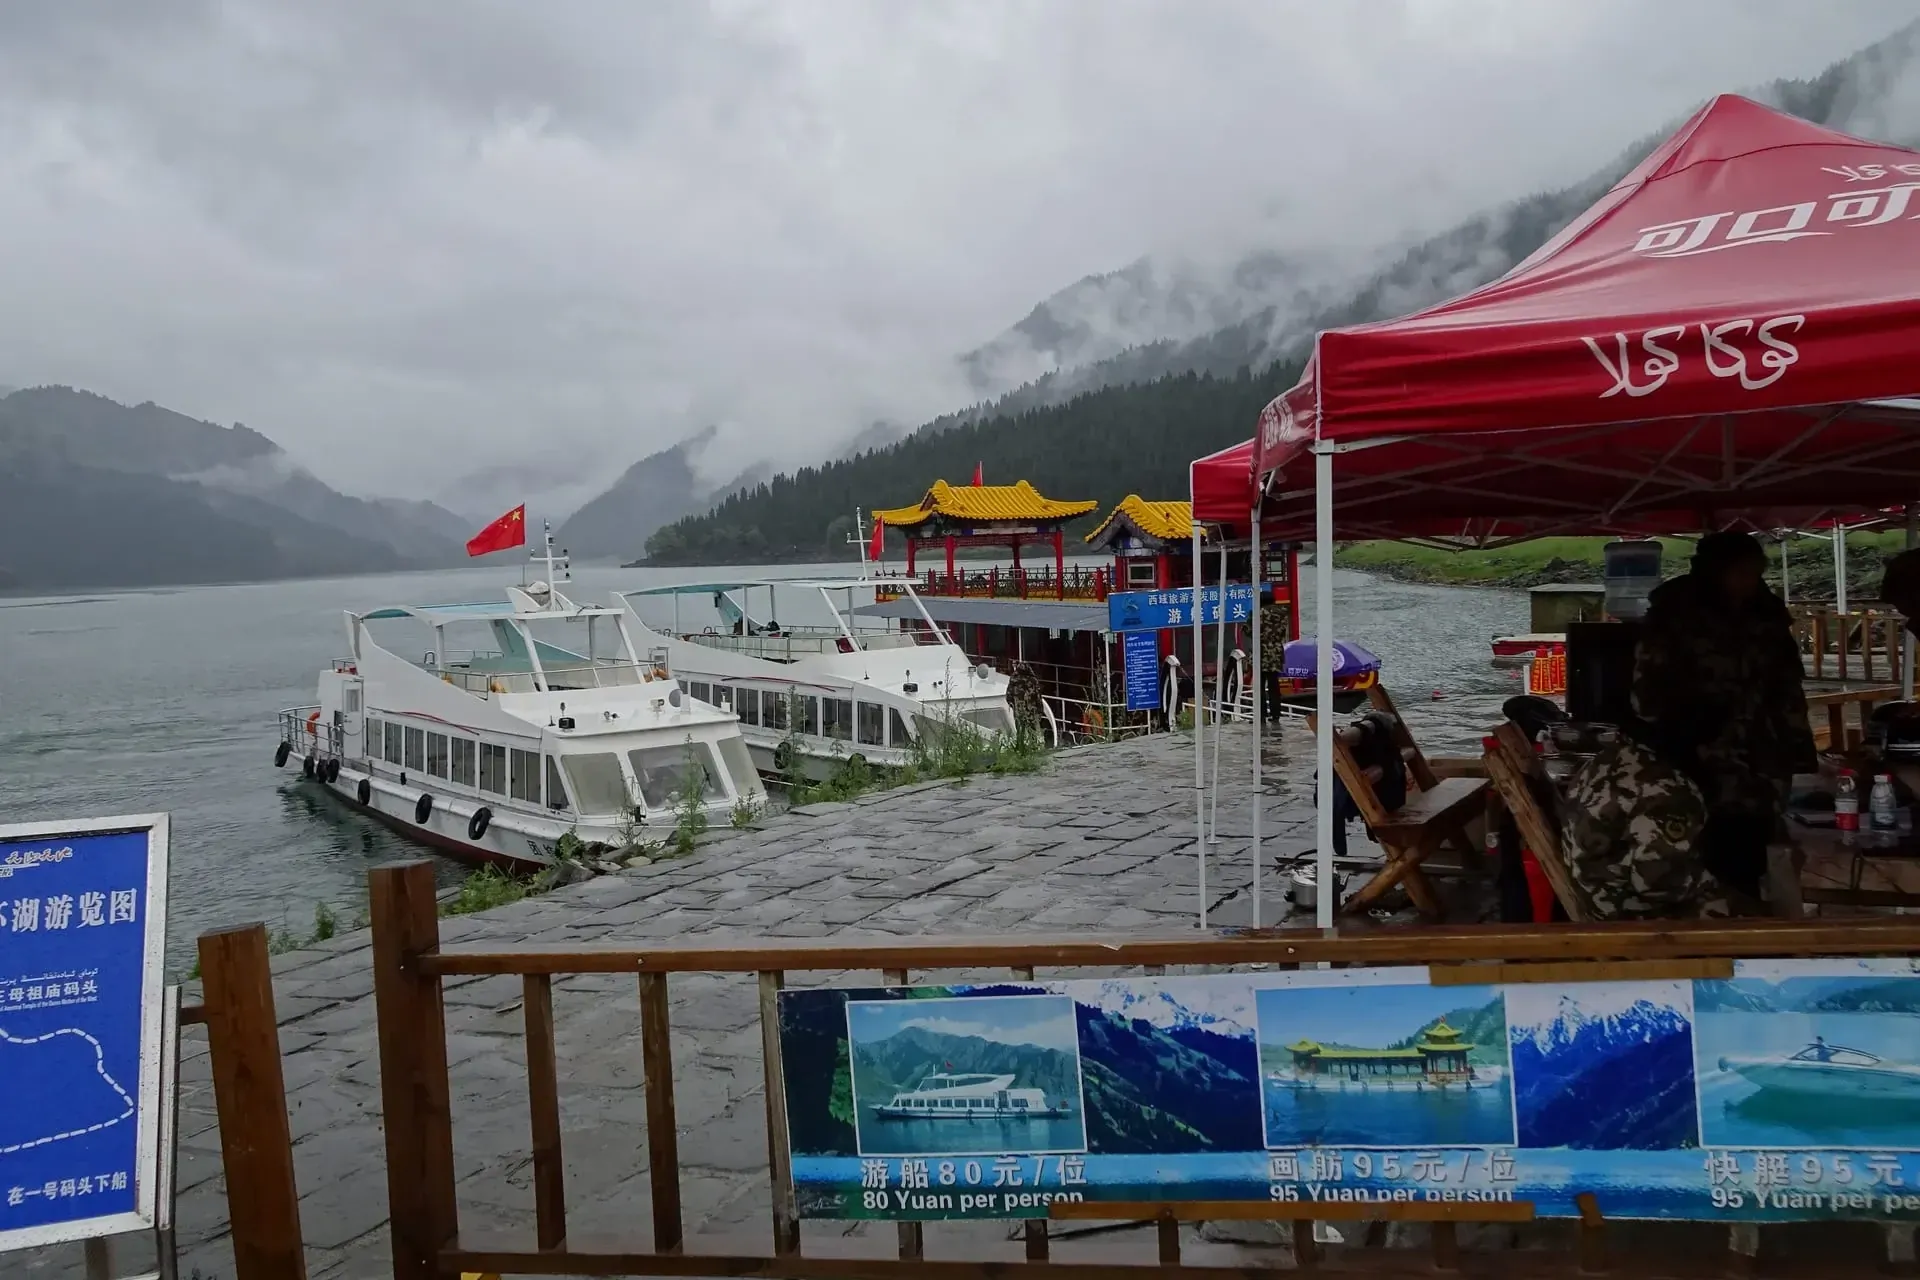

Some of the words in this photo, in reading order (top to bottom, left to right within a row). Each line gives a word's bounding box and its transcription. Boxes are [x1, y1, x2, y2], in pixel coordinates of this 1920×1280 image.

[1631, 182, 1920, 258] 可口可
[1704, 1151, 1920, 1187] 快艇95元
[7, 1171, 128, 1207] 在一号码头下船
[863, 1191, 889, 1210] 80
[895, 1190, 953, 1210] Yuan
[960, 1193, 997, 1213] per
[1004, 1190, 1084, 1212] person
[1269, 1185, 1300, 1203] 95
[1306, 1184, 1367, 1203] Yuan
[1377, 1187, 1417, 1203] per
[1426, 1187, 1513, 1203] person
[1711, 1187, 1744, 1208] 95
[1754, 1187, 1823, 1209] Yuan
[1829, 1191, 1875, 1213] per
